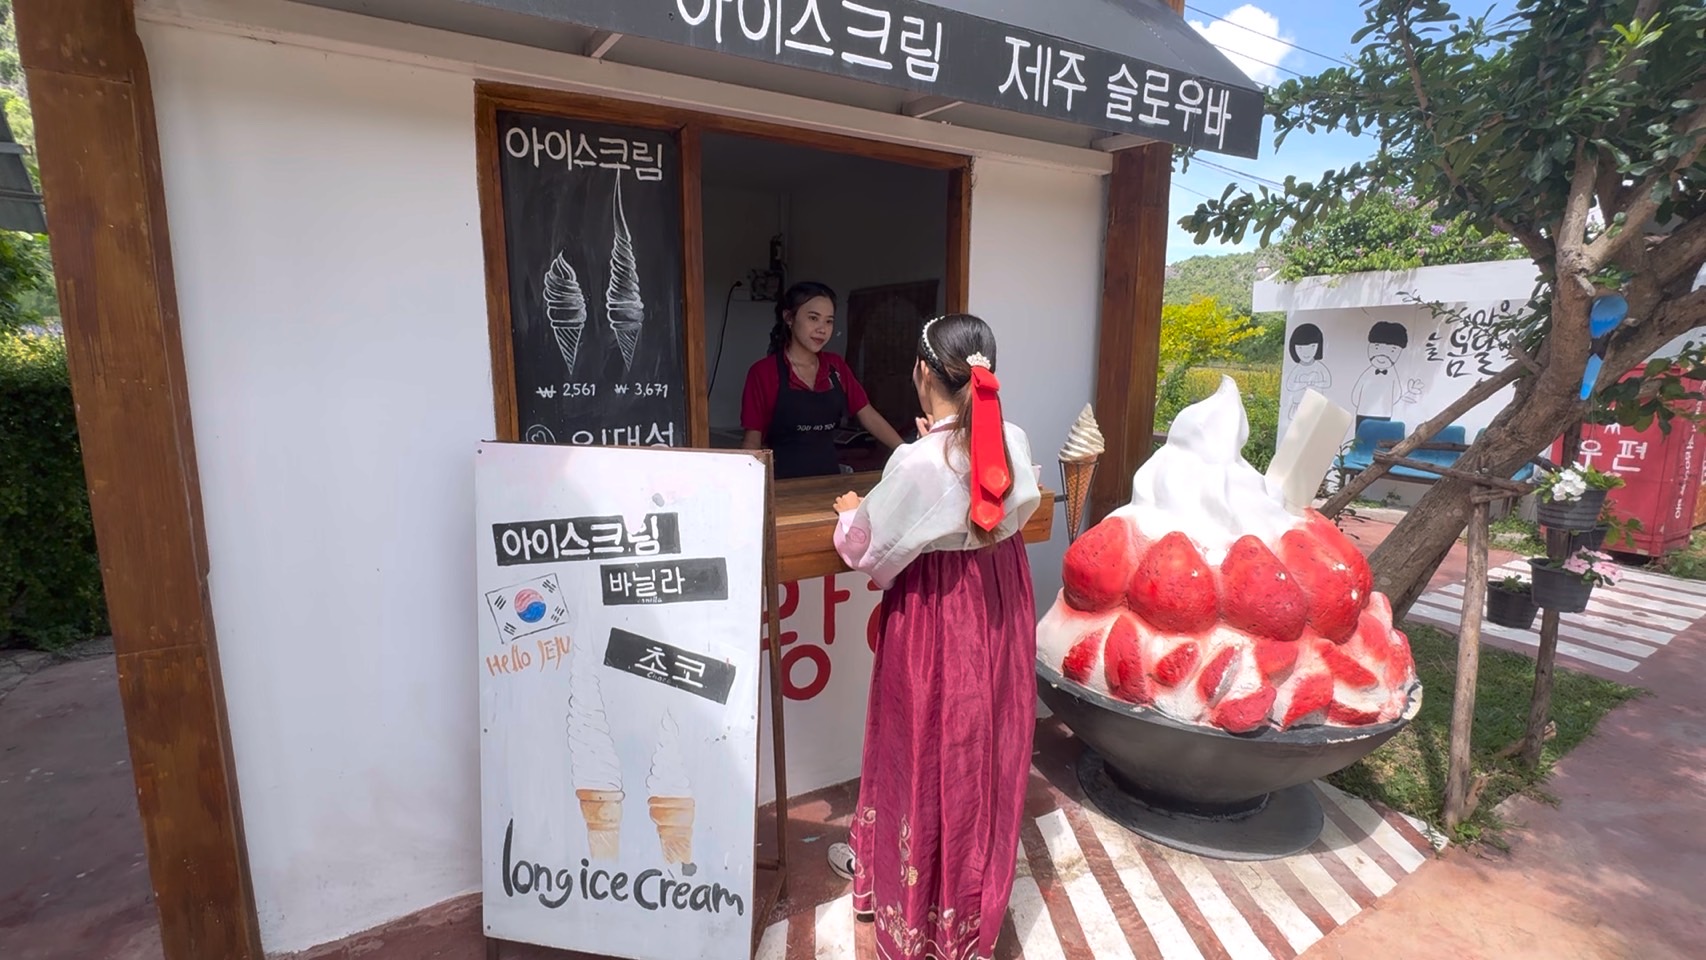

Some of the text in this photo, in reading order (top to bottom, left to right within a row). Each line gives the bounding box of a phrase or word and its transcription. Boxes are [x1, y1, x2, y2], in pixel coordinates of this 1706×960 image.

[998, 35, 1088, 112] 제주
[1105, 63, 1232, 150] 슬로우바
[505, 126, 664, 182] 아이스크림
[562, 382, 596, 398] 2,561
[634, 382, 668, 399] 3,671
[1579, 440, 1648, 472] 우편
[609, 566, 686, 598] 바닐라
[486, 644, 531, 677] Hello
[634, 646, 706, 688] 초코
[502, 818, 573, 909] long
[580, 858, 629, 901] ice
